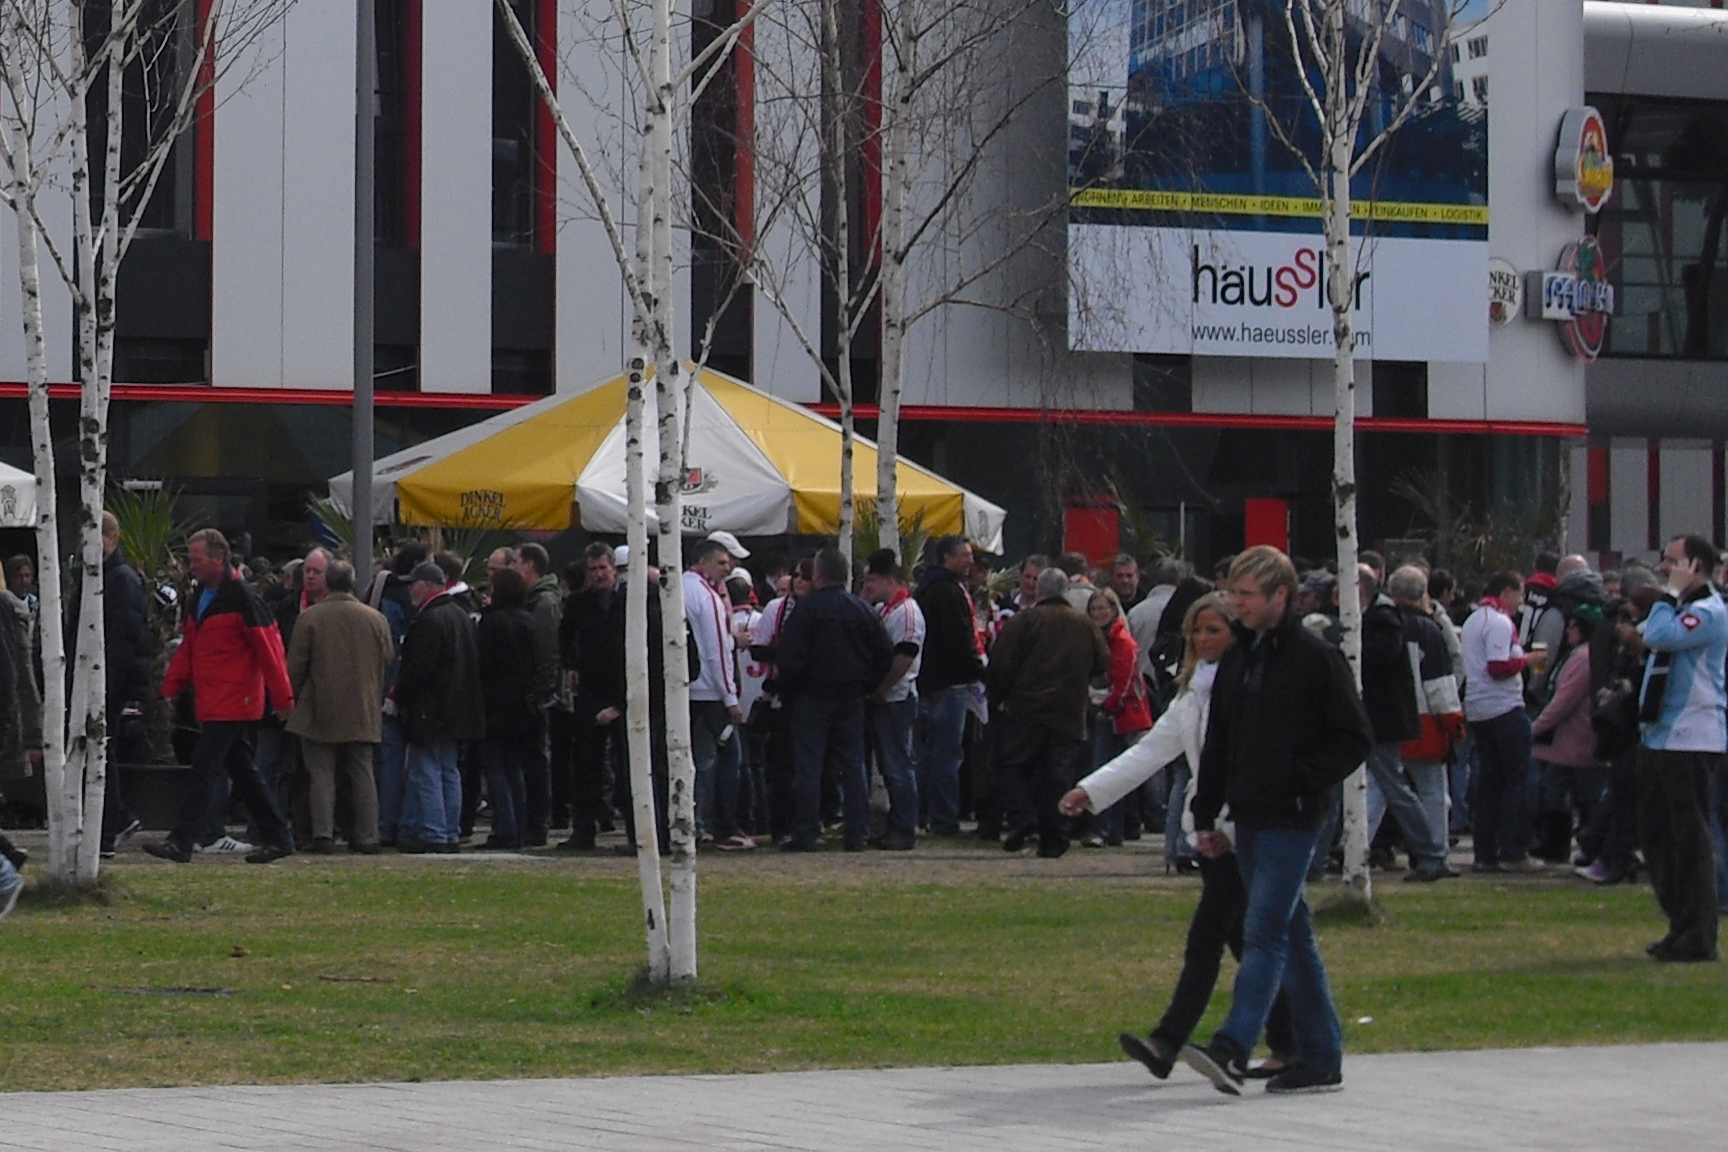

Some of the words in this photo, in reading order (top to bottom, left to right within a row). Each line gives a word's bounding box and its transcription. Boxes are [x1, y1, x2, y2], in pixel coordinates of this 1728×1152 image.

[1191, 195, 1247, 210] MENSCHEN
[1260, 199, 1289, 211] IDEEN
[1441, 208, 1483, 221] LOGISTIK
[1192, 322, 1371, 346] www.haeussler.m
